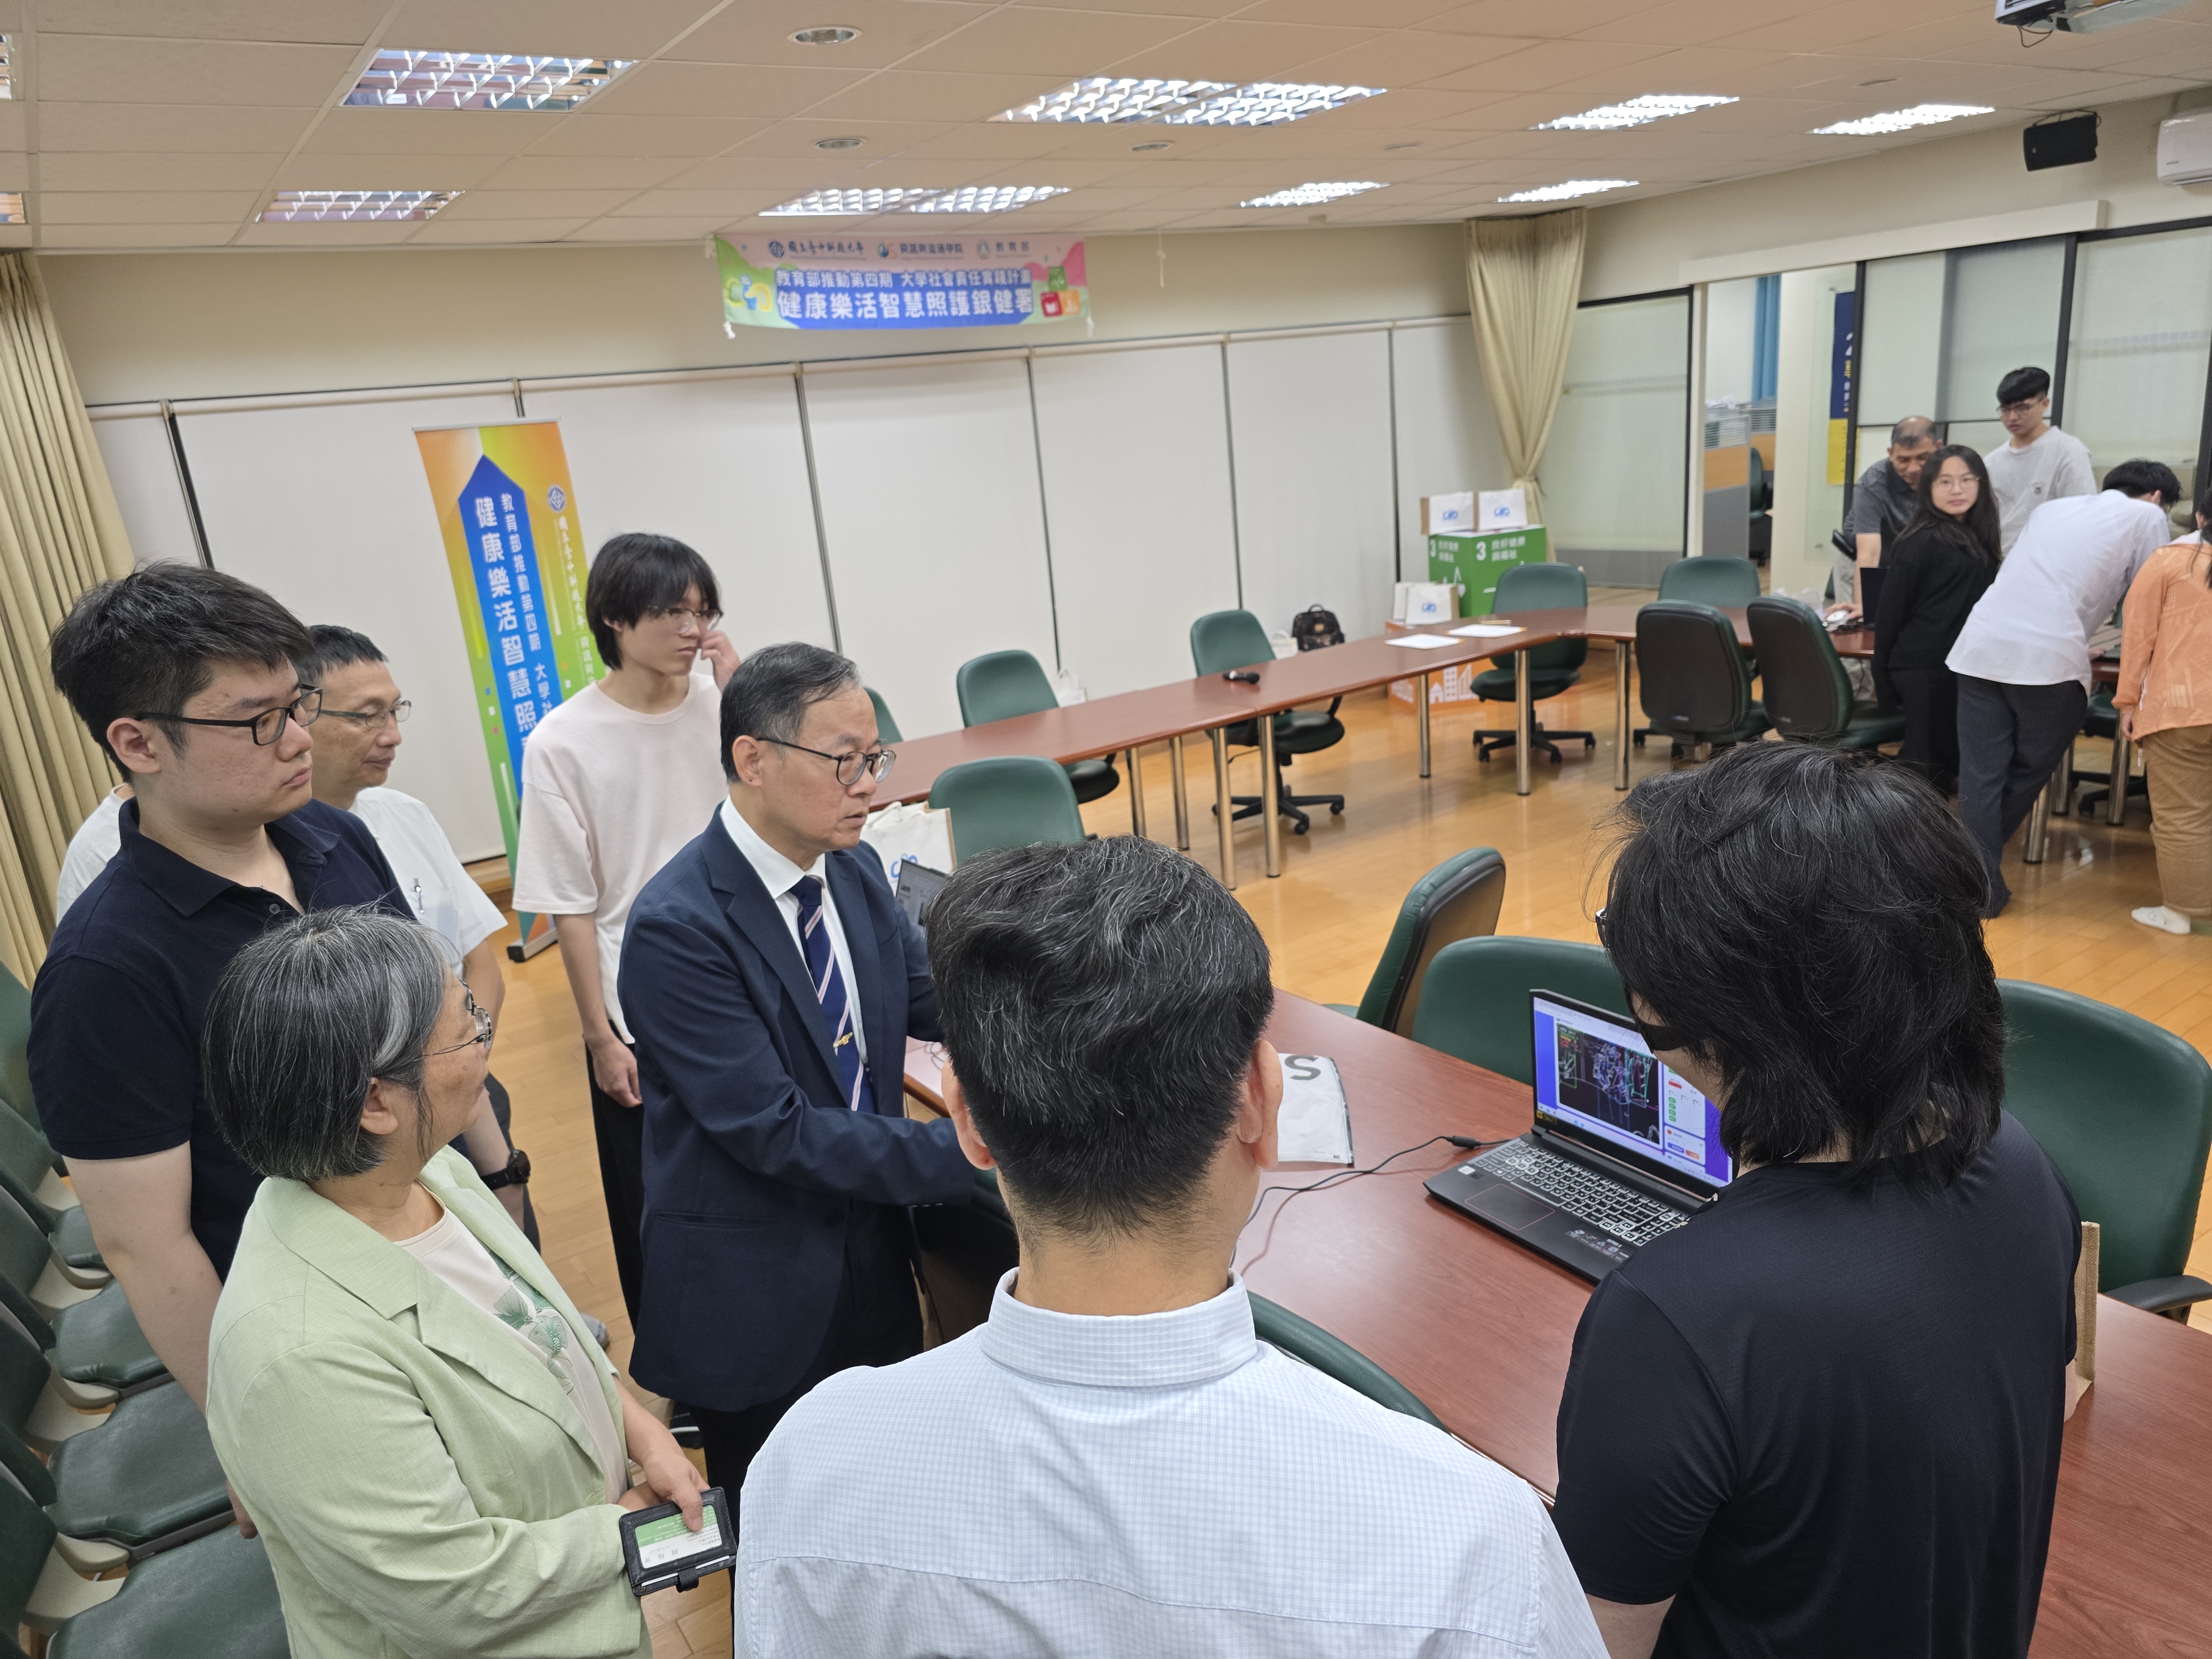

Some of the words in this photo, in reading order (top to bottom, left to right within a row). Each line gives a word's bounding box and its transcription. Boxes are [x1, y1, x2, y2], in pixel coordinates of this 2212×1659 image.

[776, 269, 893, 288] 教育部推動第四期
[778, 288, 1032, 319] 健康樂活智慧照護銀健署
[1476, 541, 1486, 561] 3
[501, 493, 541, 651] 教育部推動第四期
[475, 495, 538, 745] 健康樂活智慧照
[1284, 1055, 1321, 1081] S
